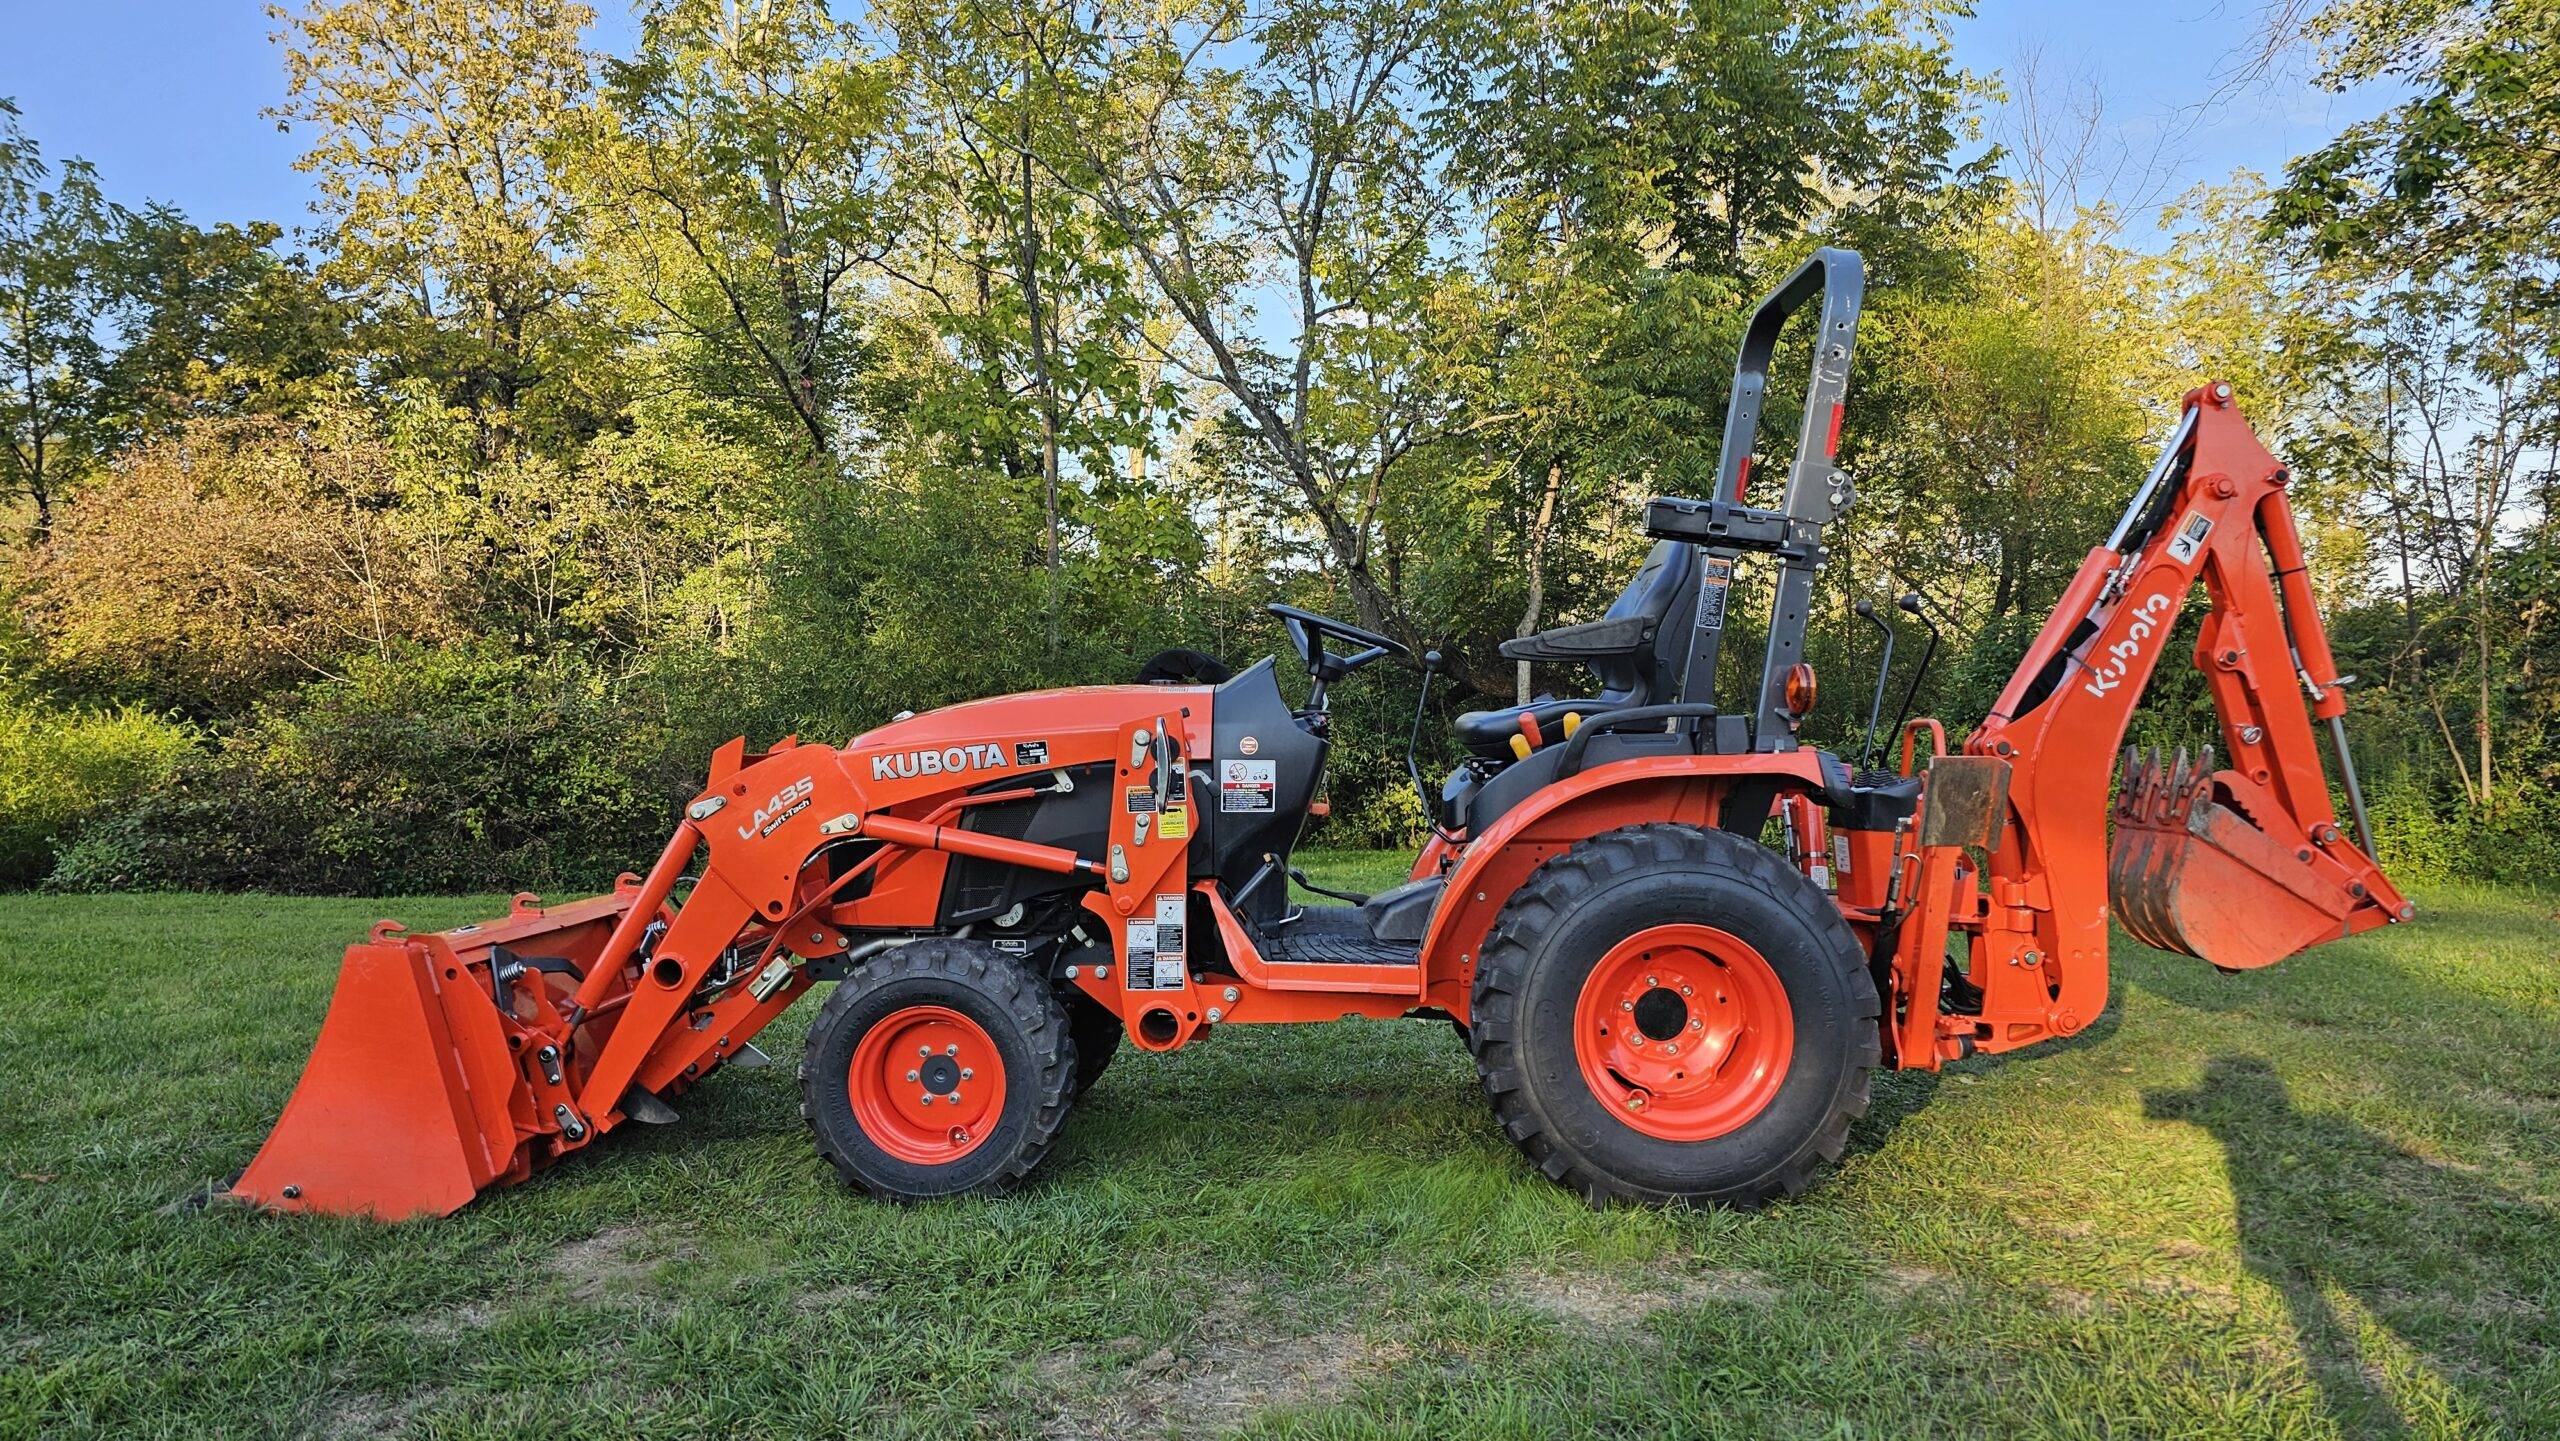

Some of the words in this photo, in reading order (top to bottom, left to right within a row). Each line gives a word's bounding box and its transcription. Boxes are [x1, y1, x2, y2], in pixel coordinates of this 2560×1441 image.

[2085, 594, 2170, 697] Kubota
[872, 743, 1008, 780] KUBOTA
[738, 776, 814, 839] LA435
[763, 800, 810, 836] Swift-Tach
